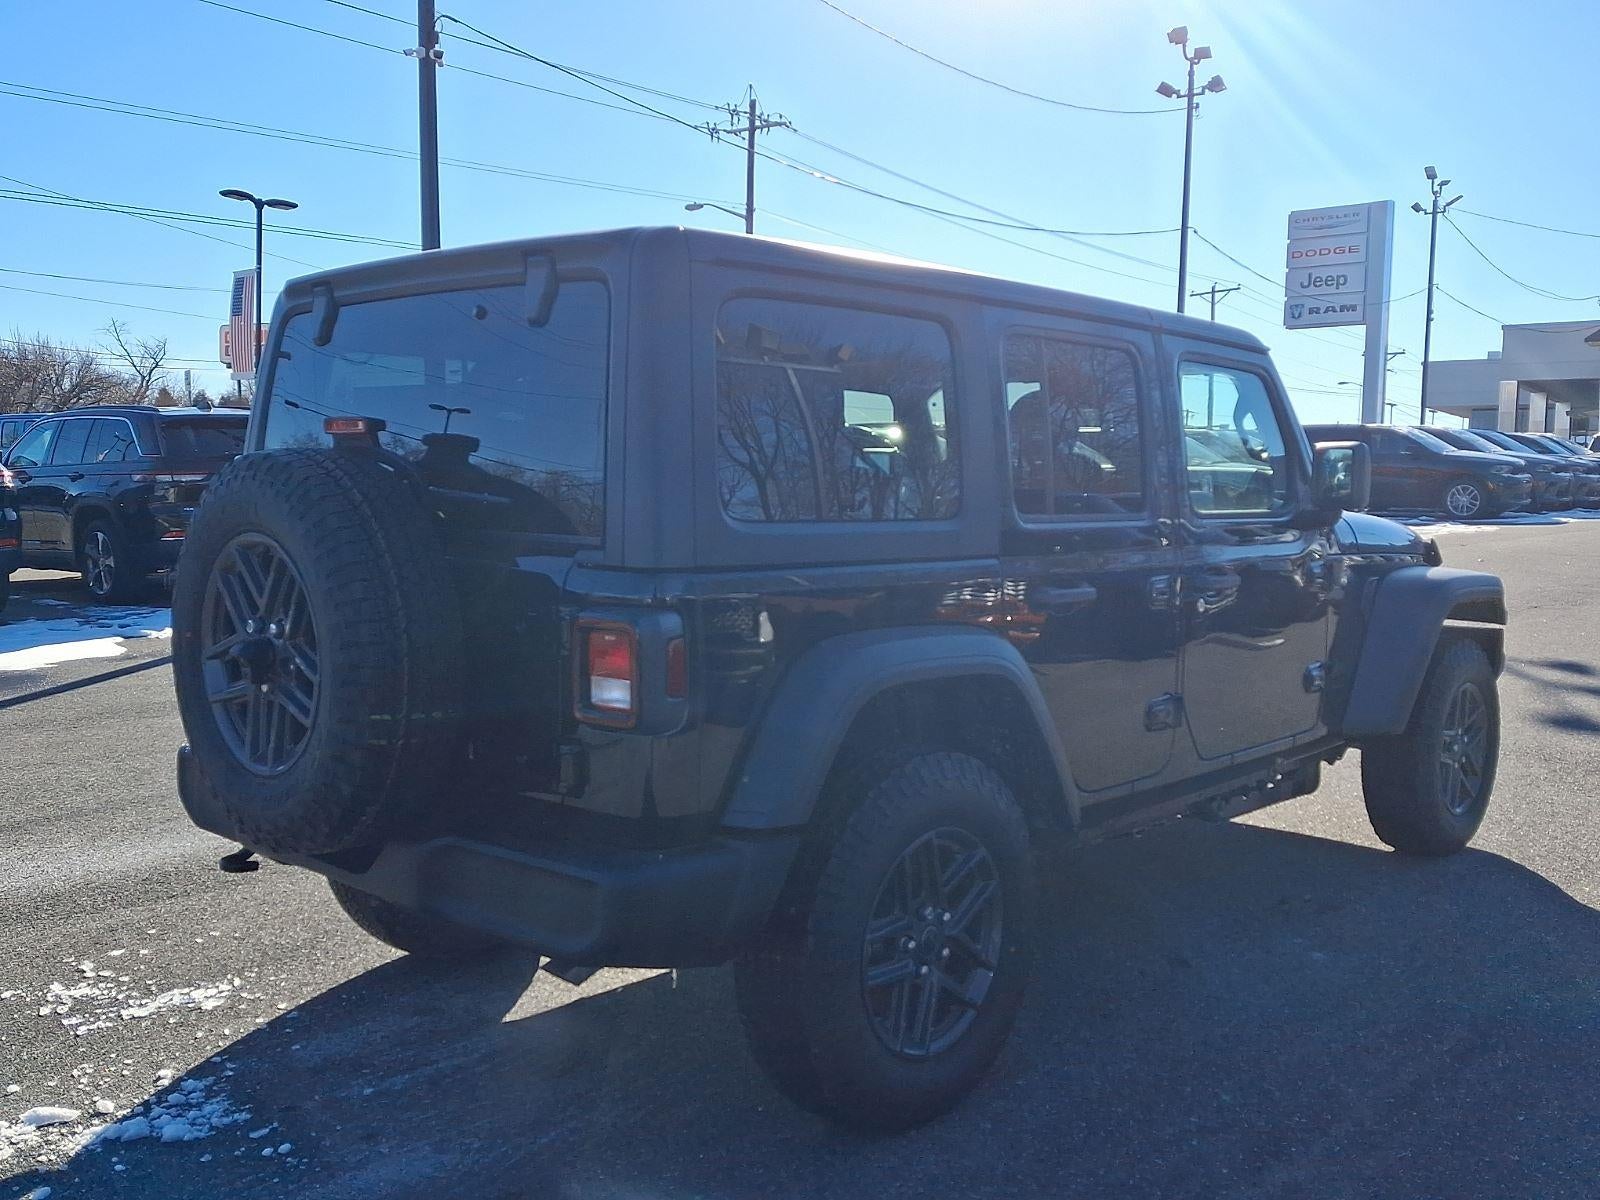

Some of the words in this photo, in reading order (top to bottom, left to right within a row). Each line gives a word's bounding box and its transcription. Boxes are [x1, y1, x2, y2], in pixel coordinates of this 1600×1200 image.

[1294, 212, 1360, 224] CHRYSLER
[1291, 244, 1361, 259] DODGE
[1300, 271, 1349, 290] Jeep
[1308, 304, 1358, 315] RAM
